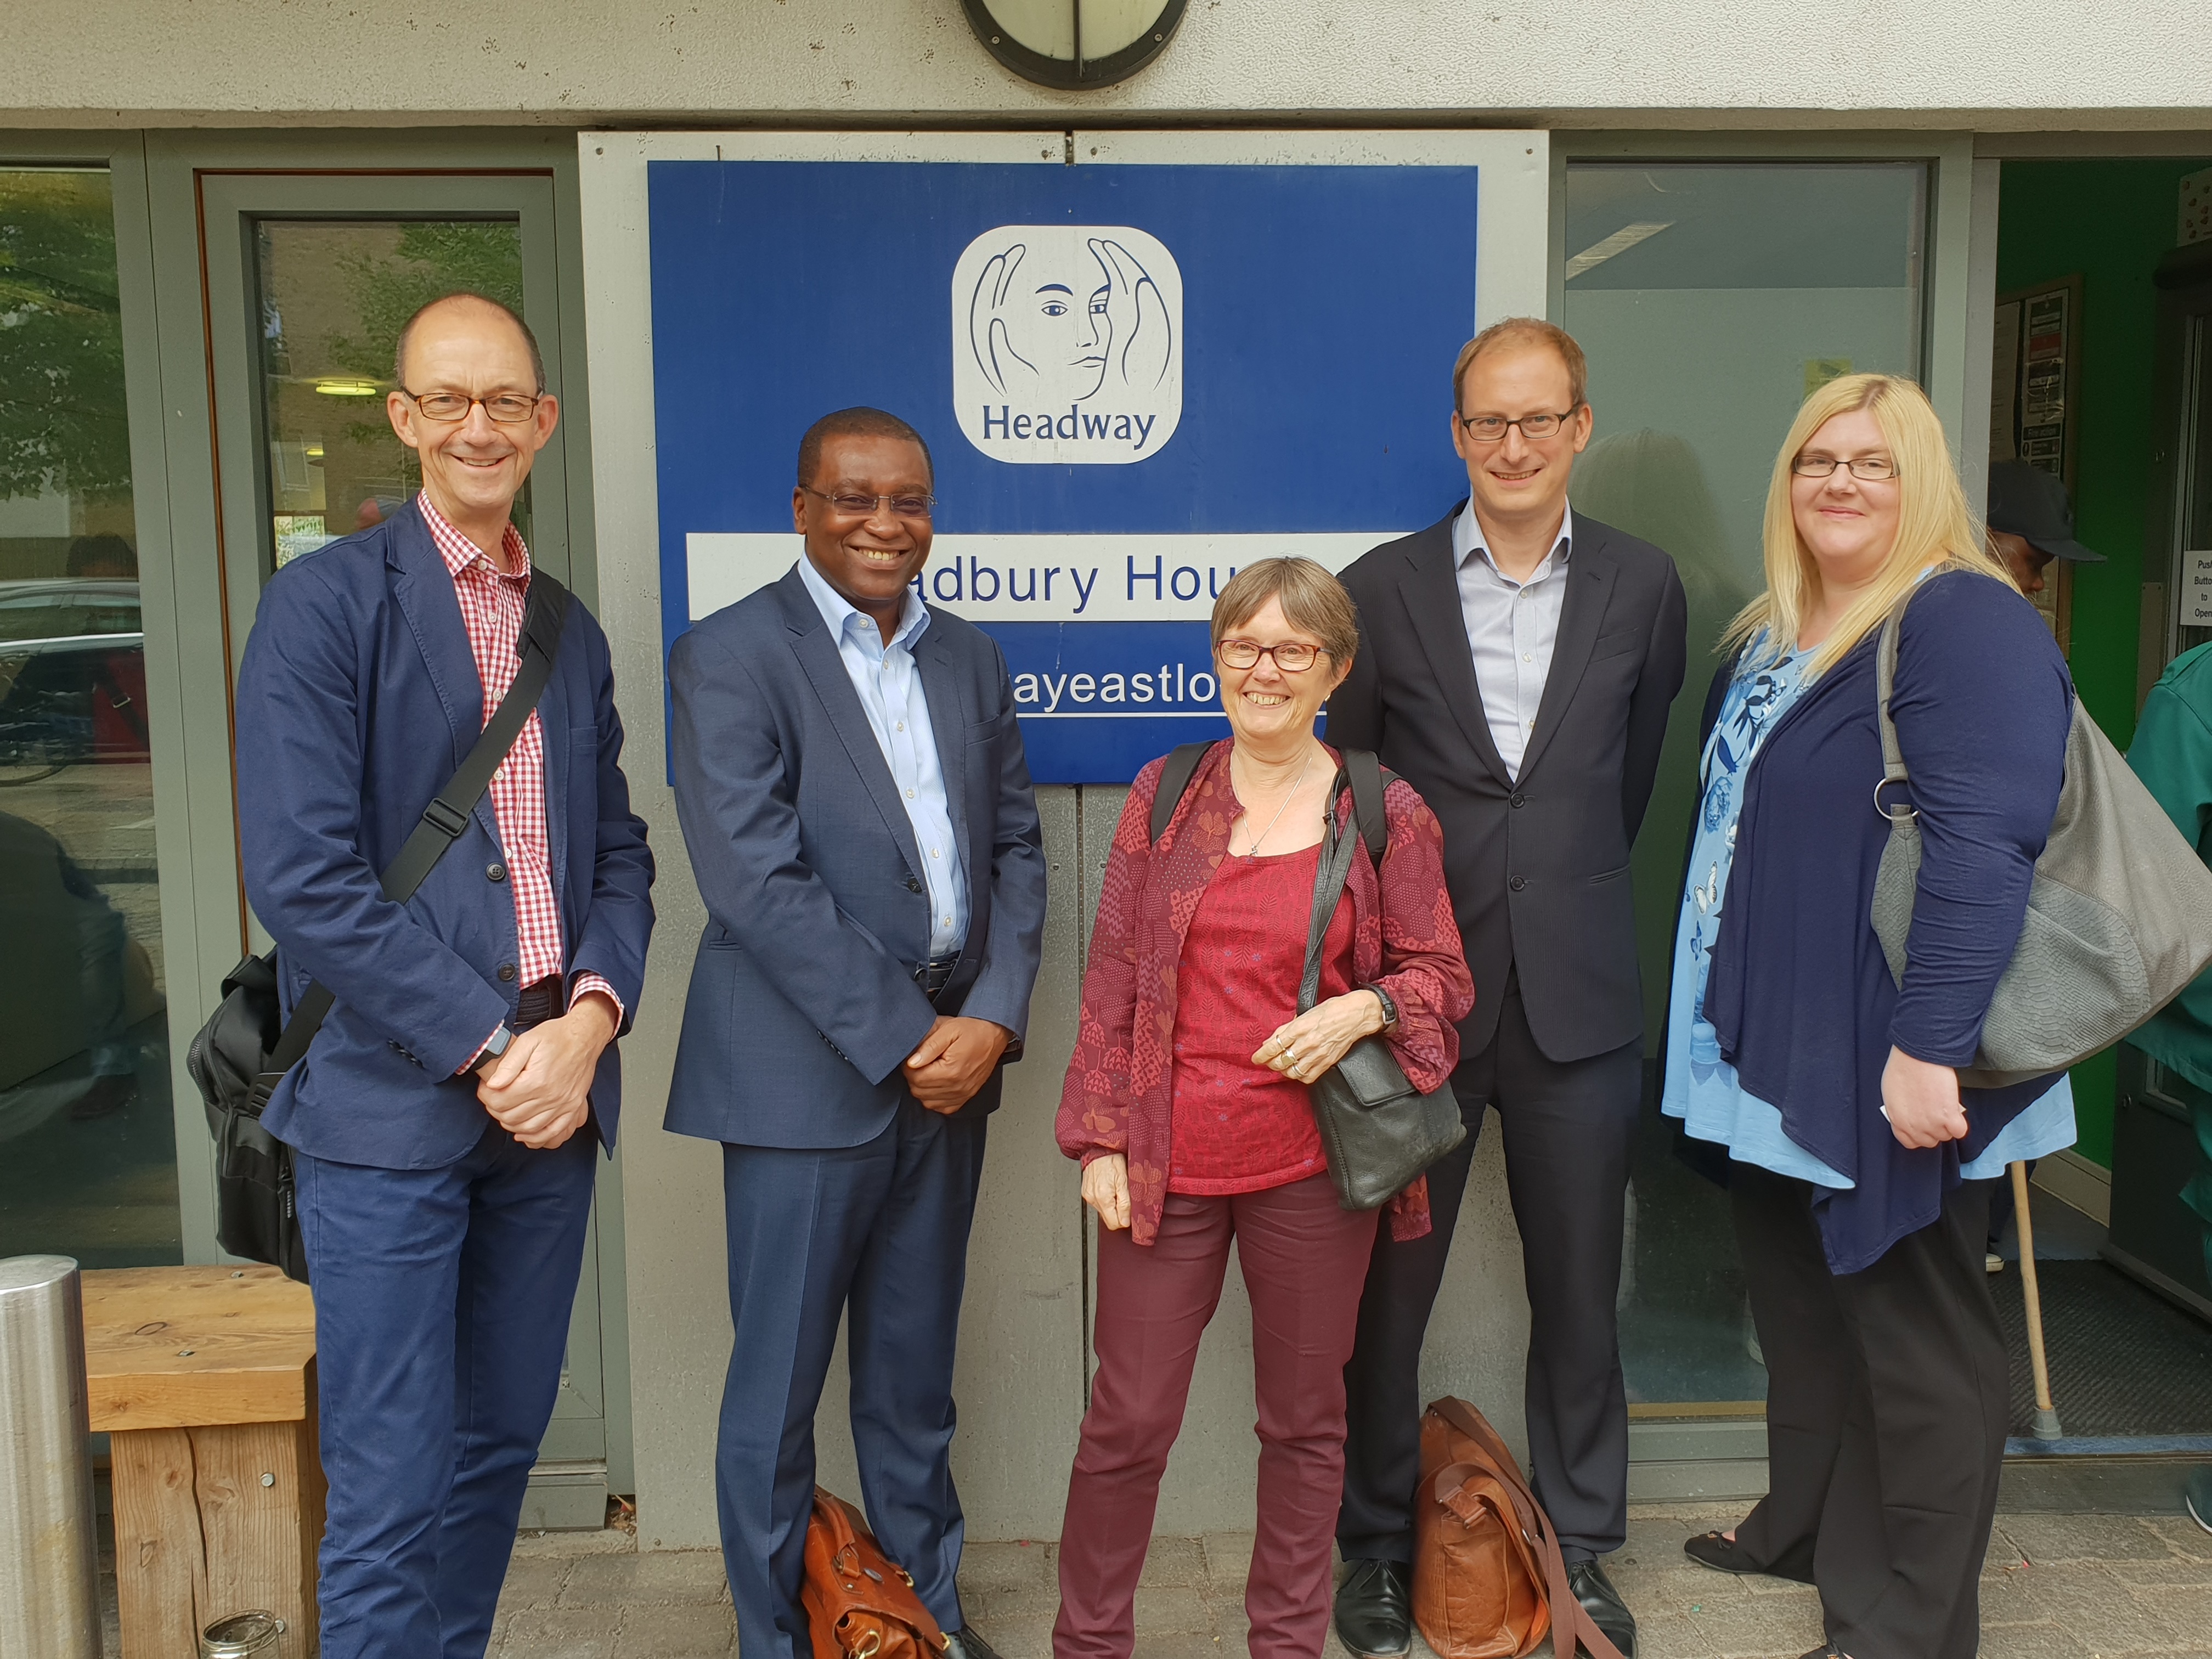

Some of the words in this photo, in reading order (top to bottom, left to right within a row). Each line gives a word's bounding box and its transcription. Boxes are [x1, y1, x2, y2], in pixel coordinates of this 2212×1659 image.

[982, 404, 1158, 451] Headway
[2201, 592, 2208, 602] to
[2194, 607, 2212, 619] Open
